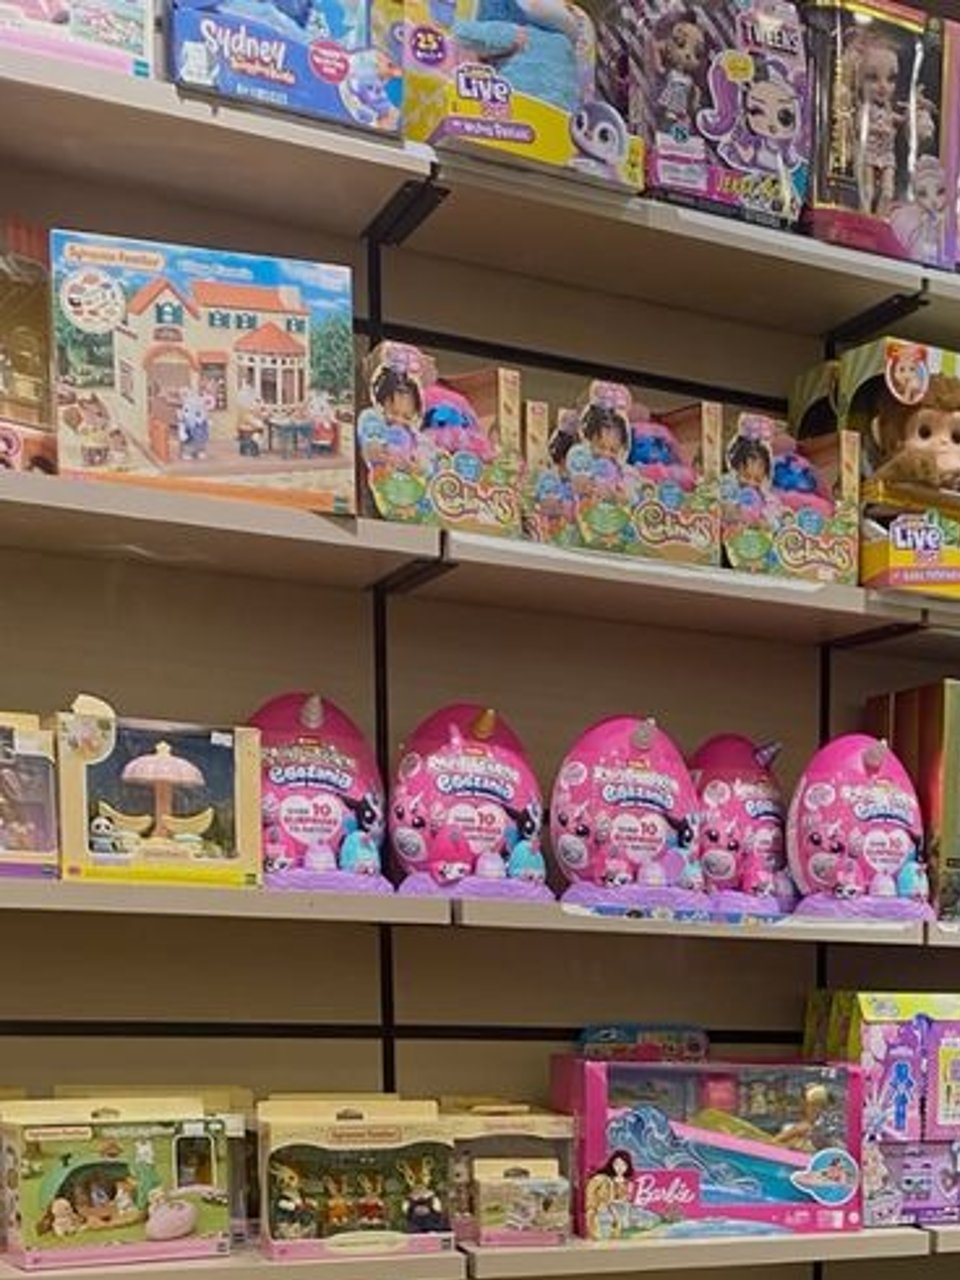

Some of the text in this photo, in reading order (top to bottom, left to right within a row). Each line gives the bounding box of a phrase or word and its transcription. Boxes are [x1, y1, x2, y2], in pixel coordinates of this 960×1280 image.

[201, 19, 287, 69] Sydney
[458, 74, 510, 102] Live
[894, 524, 941, 550] Live
[312, 804, 332, 818] 10
[479, 812, 496, 826] 10
[640, 821, 658, 835] 10
[634, 1173, 695, 1205] Barbie
